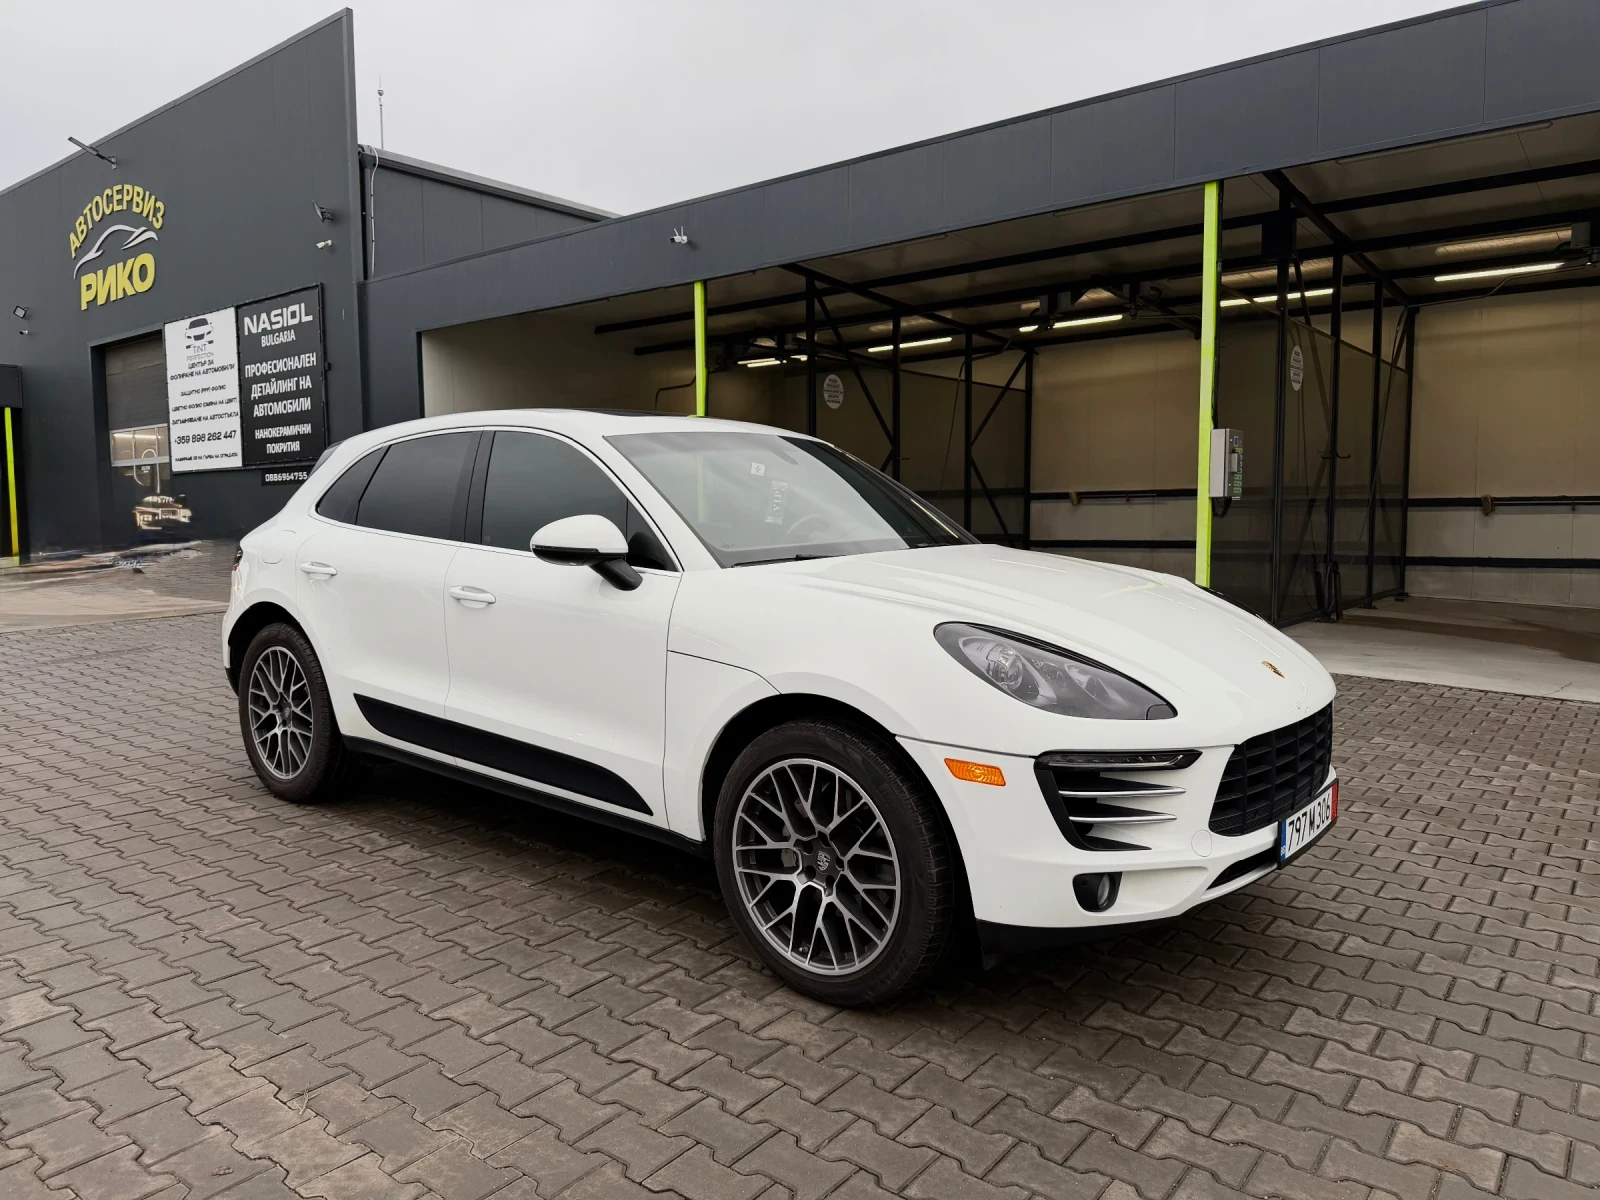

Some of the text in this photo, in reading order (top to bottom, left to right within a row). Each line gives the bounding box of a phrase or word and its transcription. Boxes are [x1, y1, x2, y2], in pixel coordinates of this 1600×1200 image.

[69, 184, 165, 259] АВТОСЕРВИЗ
[81, 253, 155, 310] РИКО
[244, 302, 313, 335] NASIOL
[261, 329, 296, 347] BULGARIA
[187, 352, 214, 361] PERFECTION
[193, 344, 206, 354] TINT
[188, 360, 207, 369] ЦЕНТЪР
[202, 363, 235, 374] АВТОМОБИЛИ
[245, 352, 316, 378] ПРОФЕСИОНАЛЕН
[251, 375, 312, 400] ДЕТАЙЛИНГ НА
[254, 397, 311, 417] АВТОМОБИЛИ
[174, 430, 236, 444] +359 898 262 447
[255, 423, 311, 439] НАНОКЕРАМИЧНИ
[266, 441, 300, 454] ПОКРИТИЯ
[1288, 793, 1330, 852] 797 M 306
